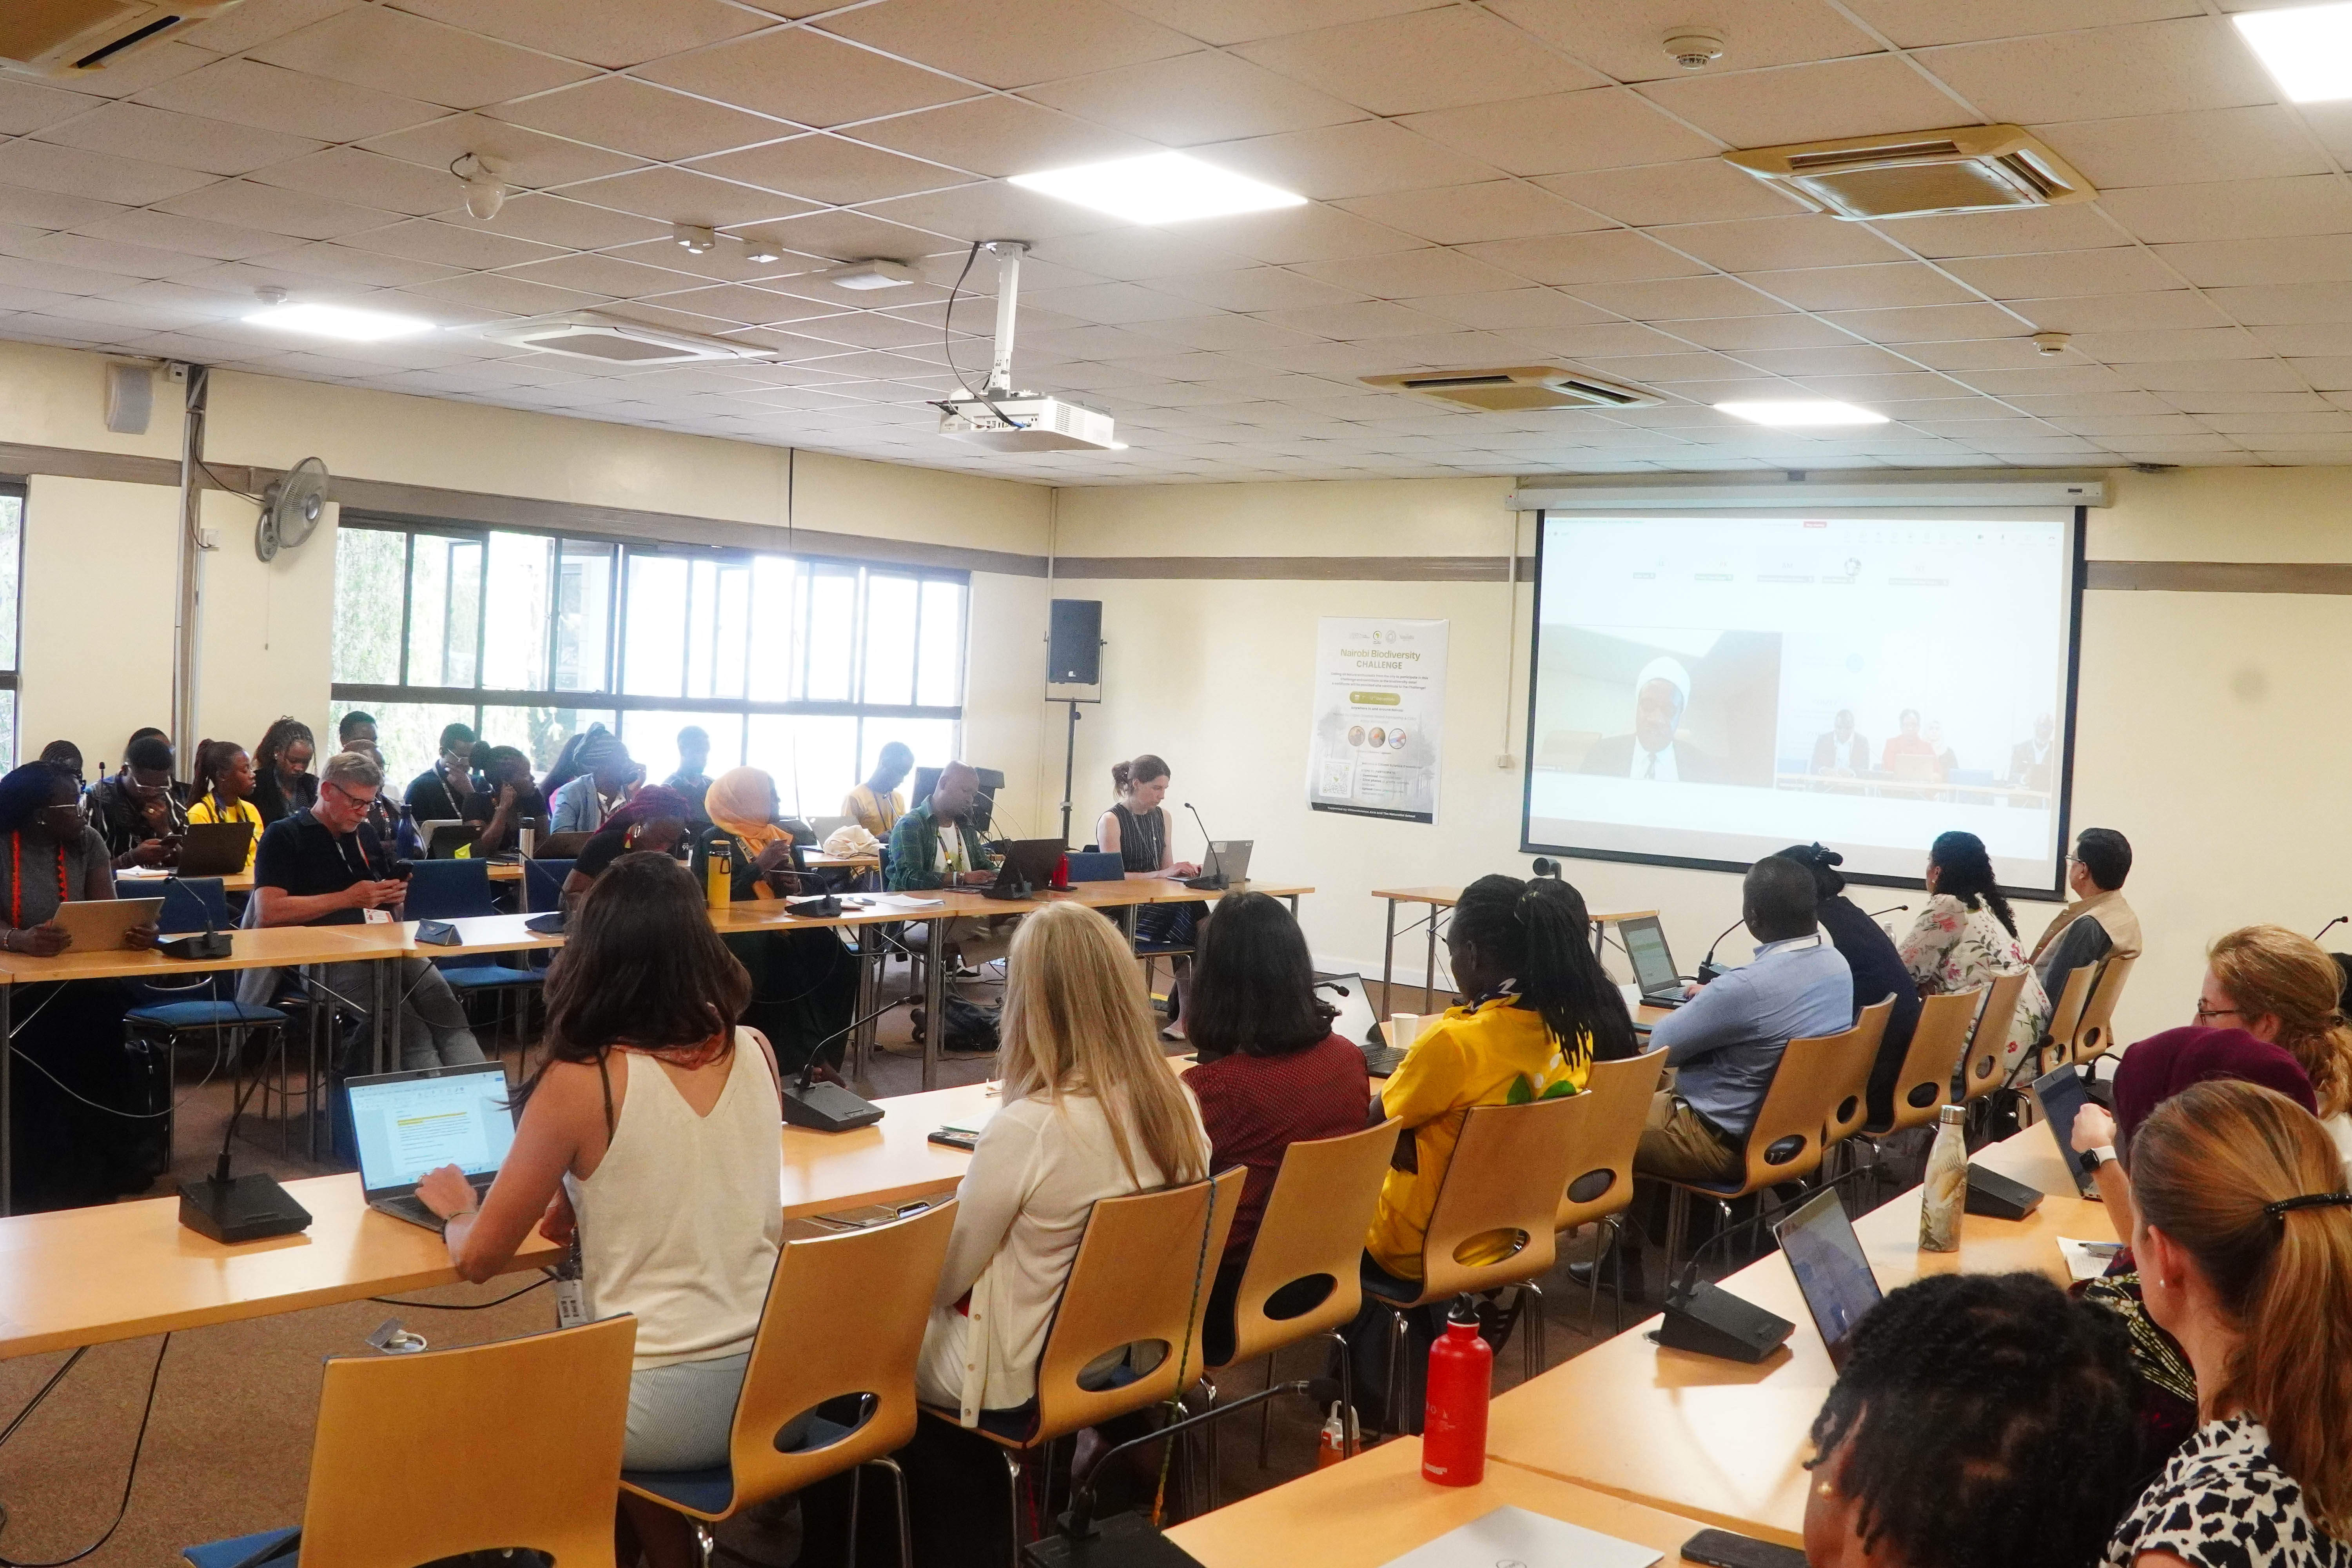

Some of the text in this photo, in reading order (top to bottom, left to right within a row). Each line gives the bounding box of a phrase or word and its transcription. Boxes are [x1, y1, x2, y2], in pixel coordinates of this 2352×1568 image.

[1341, 649, 1421, 661] Nairobi Biodiversity
[1357, 660, 1402, 669] CHALLENGE
